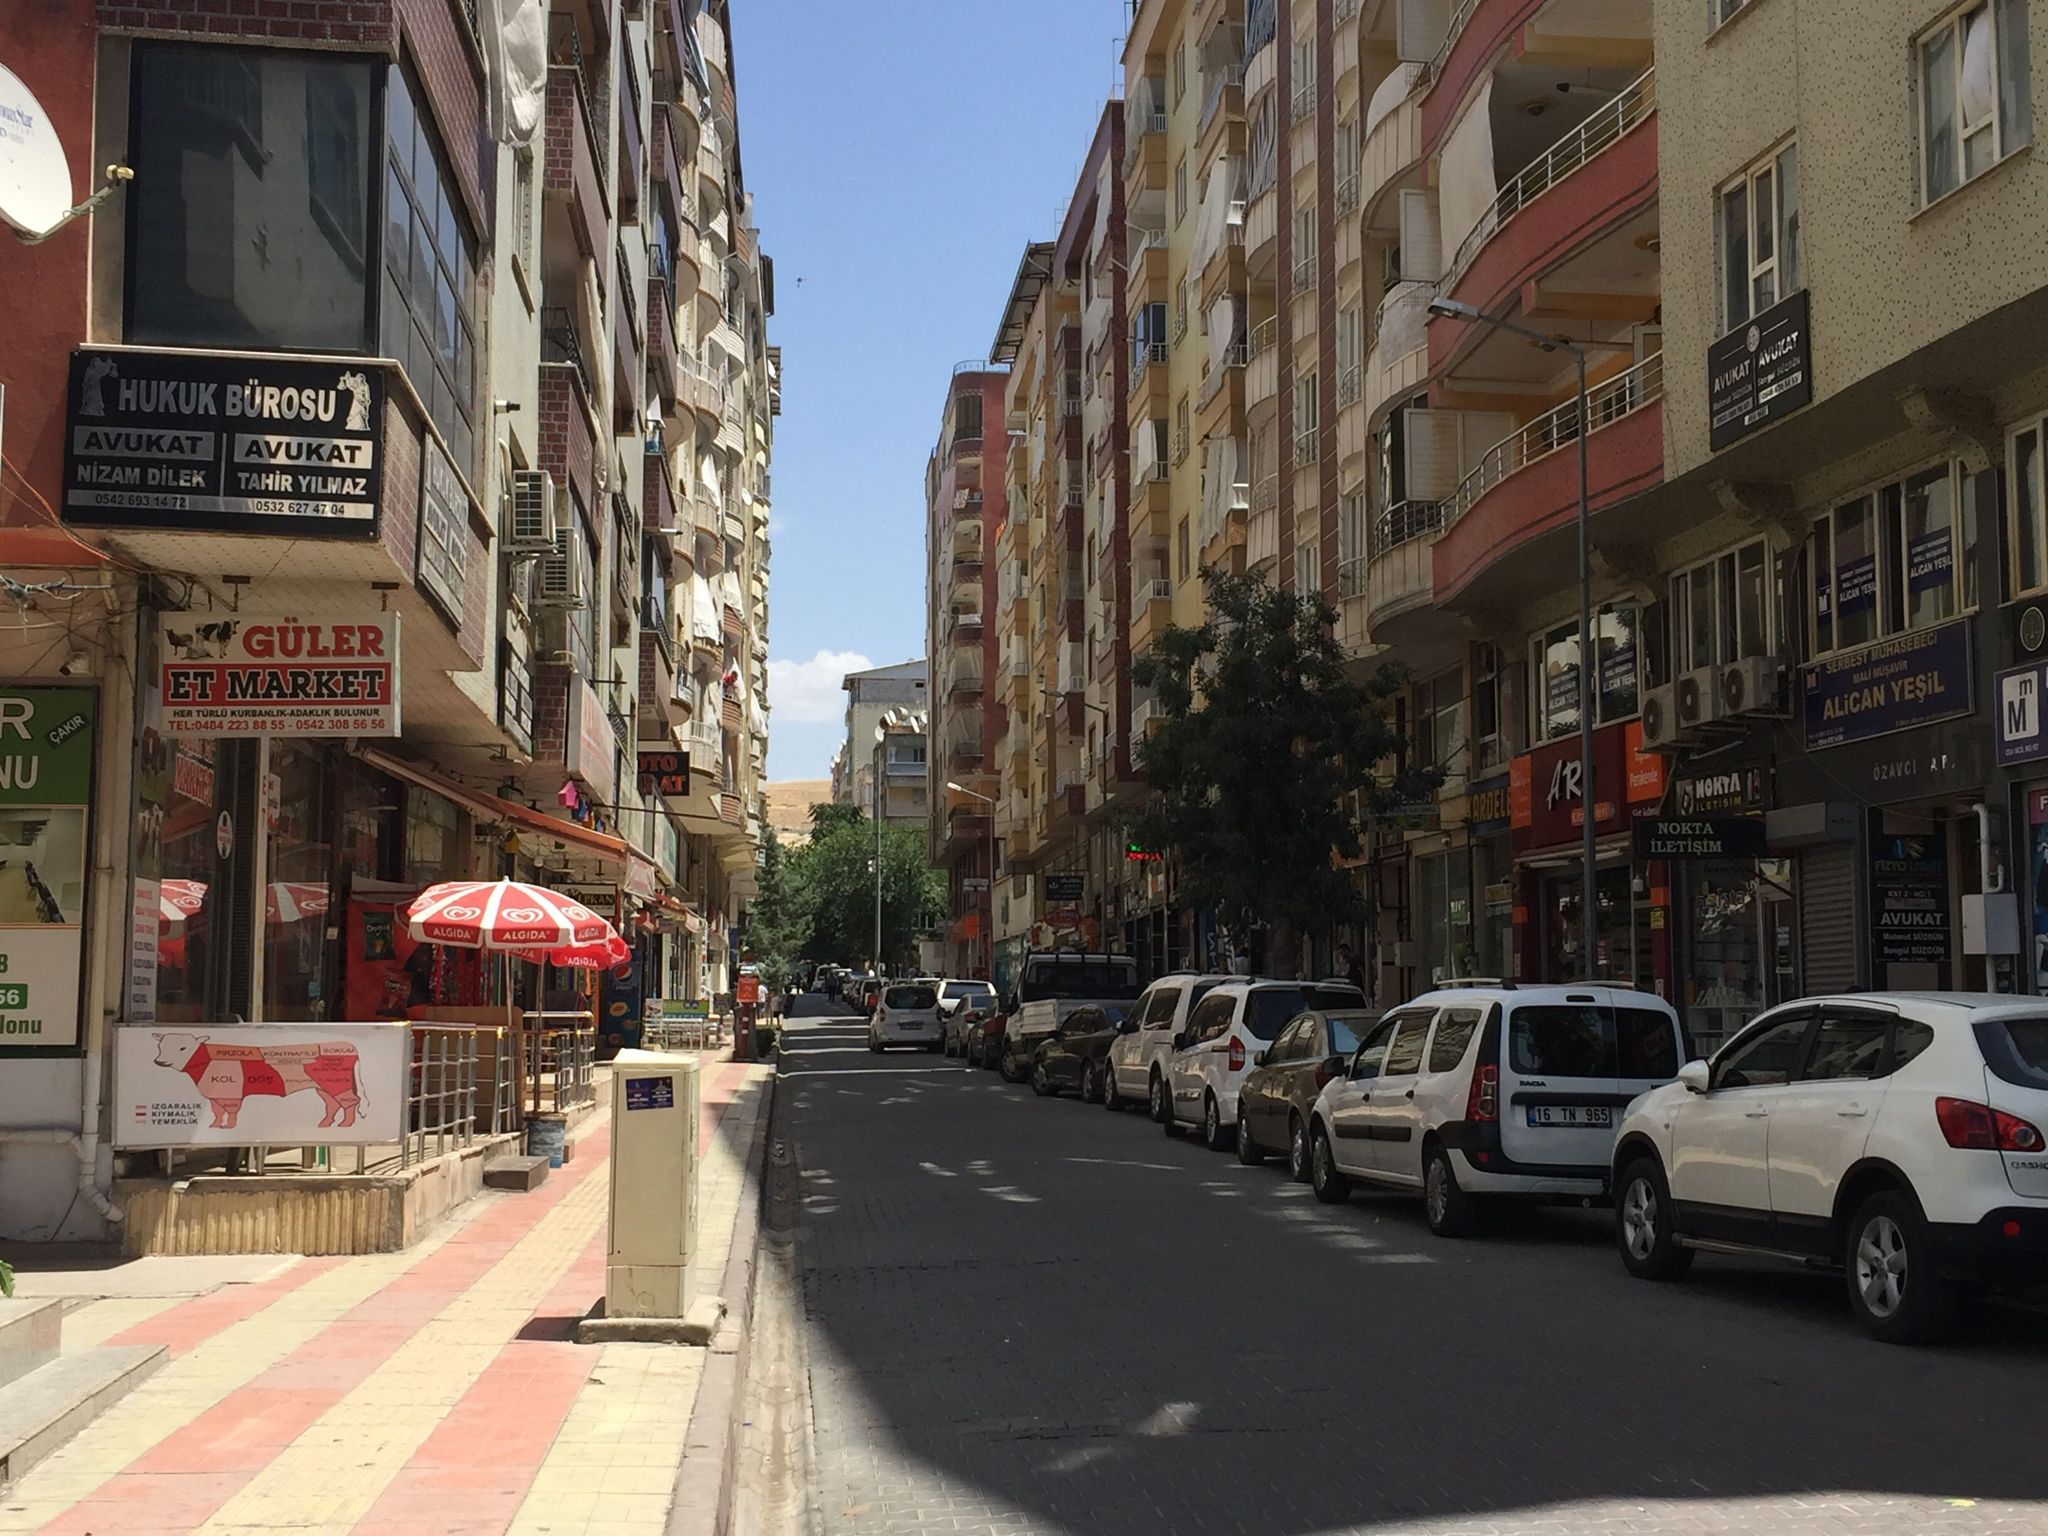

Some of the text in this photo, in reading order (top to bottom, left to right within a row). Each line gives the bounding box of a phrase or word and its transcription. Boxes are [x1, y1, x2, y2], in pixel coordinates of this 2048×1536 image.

[1758, 331, 1799, 368] AVUKAT
[1713, 359, 1750, 393] AVUKAT
[118, 379, 336, 422] HUKUK BÜROSU
[84, 432, 203, 455] AVUKAT
[244, 440, 362, 463] AVUKAT
[77, 464, 207, 488] NİZAM DİLEK
[237, 470, 367, 496] TAHİR YILMAZ
[95, 493, 186, 508] 0542 693 14 72
[256, 501, 345, 515] 0532 627 47 04
[242, 616, 384, 658] GÜLER
[1826, 632, 1937, 674] SERBEST MUHASEBECİ
[170, 669, 383, 701] ET MARKET
[1823, 684, 1886, 721] ALİCAN
[1890, 670, 1945, 703] YEŞİL
[0, 697, 35, 740] R
[173, 708, 380, 718] HER TÜRLÜ KURBANLIK-ADAKLIK BULUNUR
[227, 719, 249, 731] 223
[253, 719, 268, 730] 88
[271, 719, 285, 730] 55
[295, 719, 325, 730] 0542
[328, 718, 350, 730] 308
[353, 718, 368, 729] 56
[371, 718, 385, 729] 56
[50, 714, 85, 744] ÇAKIR
[1695, 772, 1741, 799] NOKTA
[1657, 822, 1714, 834] NOKTA
[1650, 838, 1722, 855] İLETİŞİM
[1881, 912, 1943, 925] AVUKAT
[433, 927, 471, 940] ALGIDA
[502, 930, 546, 940] ALGIDA
[211, 1075, 236, 1083] KOL
[1536, 1107, 1608, 1122] 16 TN 965
